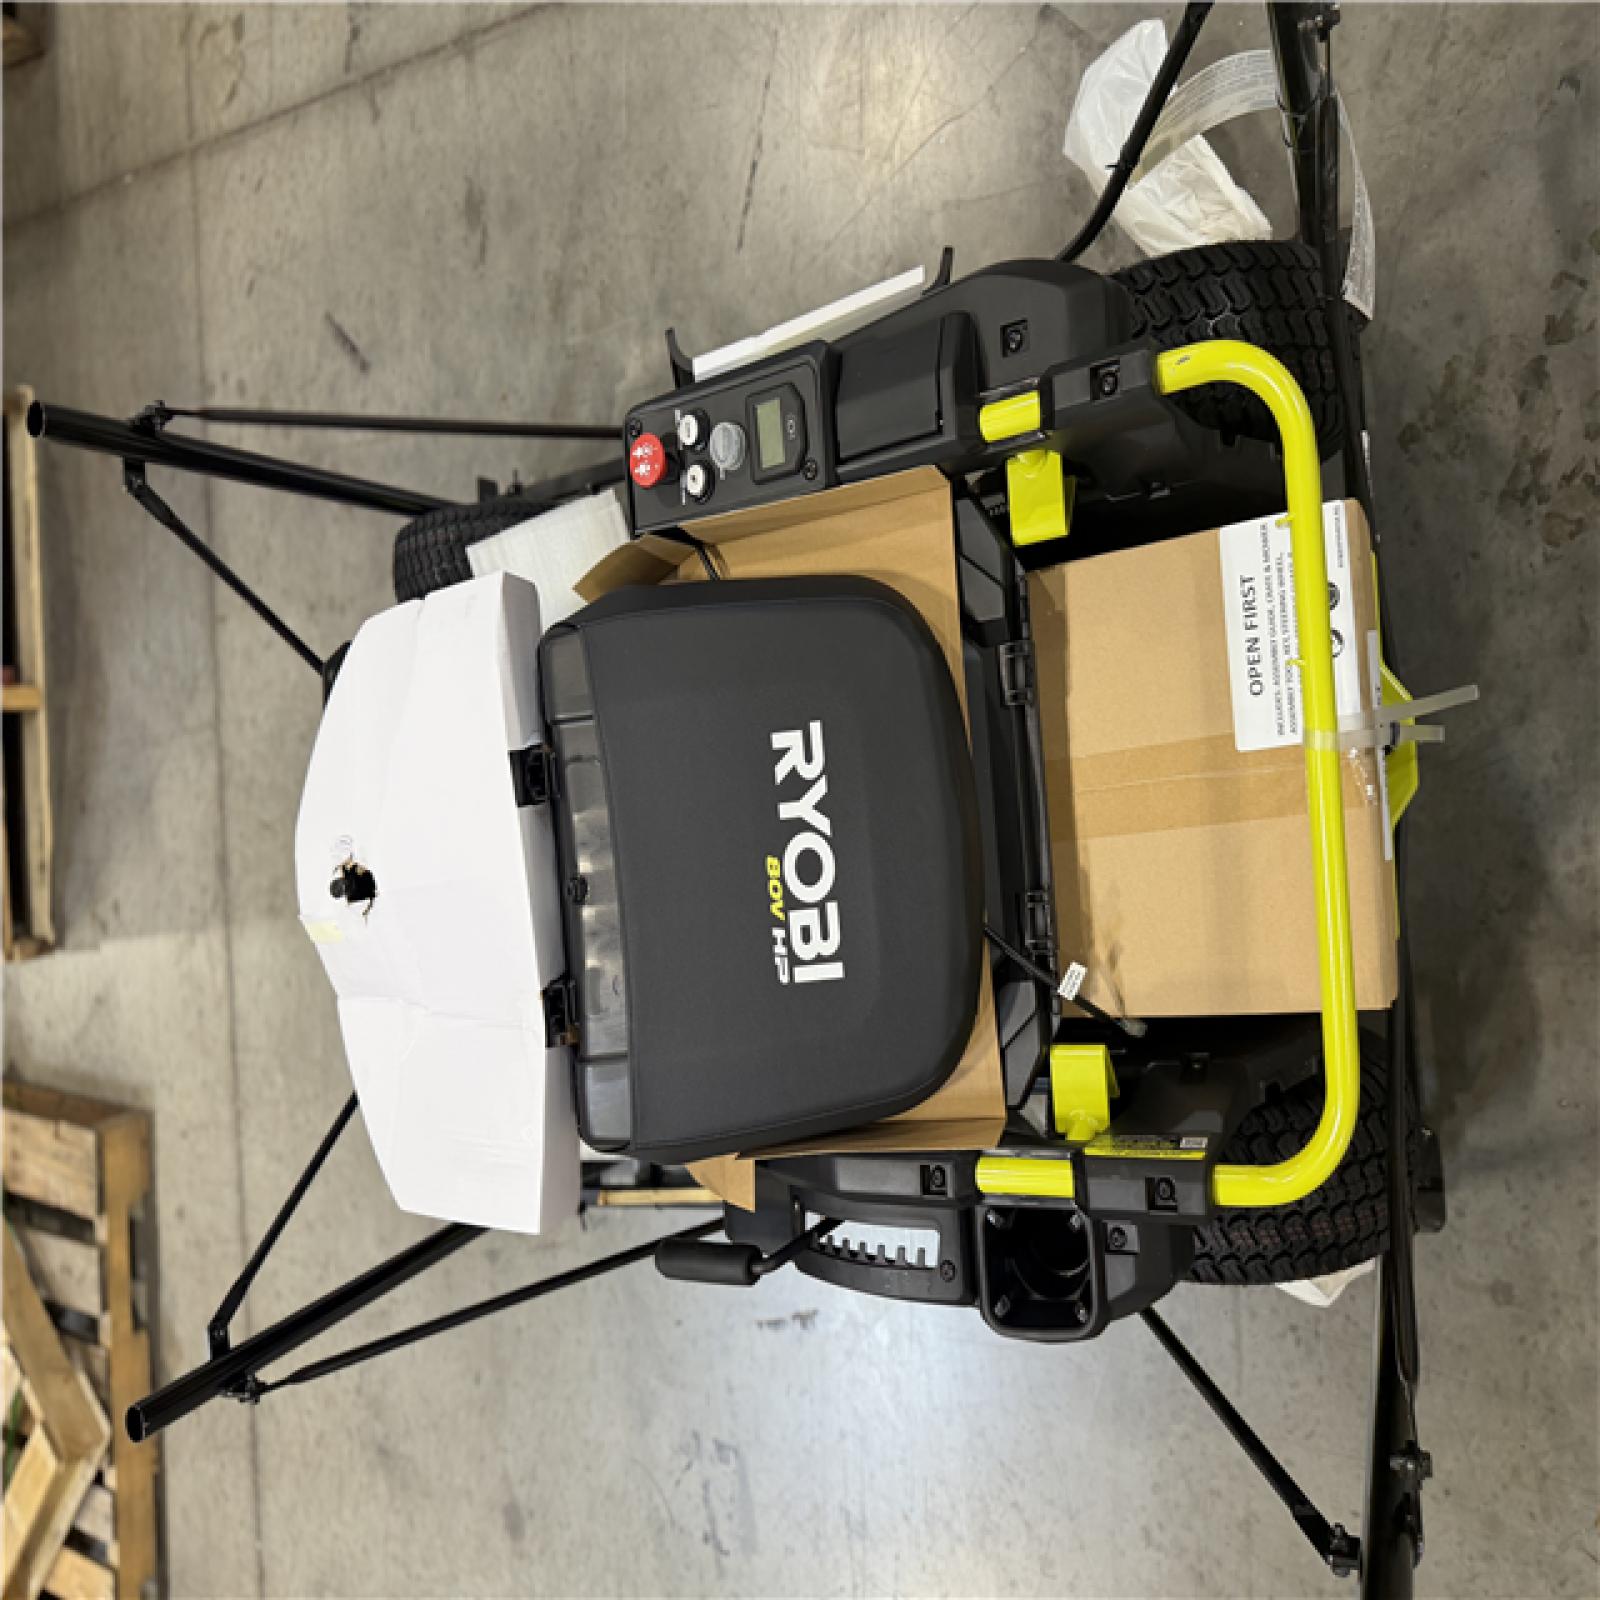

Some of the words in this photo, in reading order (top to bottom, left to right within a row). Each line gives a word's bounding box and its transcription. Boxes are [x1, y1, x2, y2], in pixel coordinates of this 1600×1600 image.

[1260, 524, 1270, 563] MOWER
[1239, 575, 1258, 631] FIRST
[1279, 590, 1290, 636] STEERING
[1244, 637, 1264, 697] OPEN
[1270, 640, 1280, 686] ASSEMBLY
[1287, 688, 1297, 734] ASSEMBLY
[770, 719, 845, 984] RYOBI
[765, 855, 786, 921] 80V
[772, 927, 790, 984] HP
